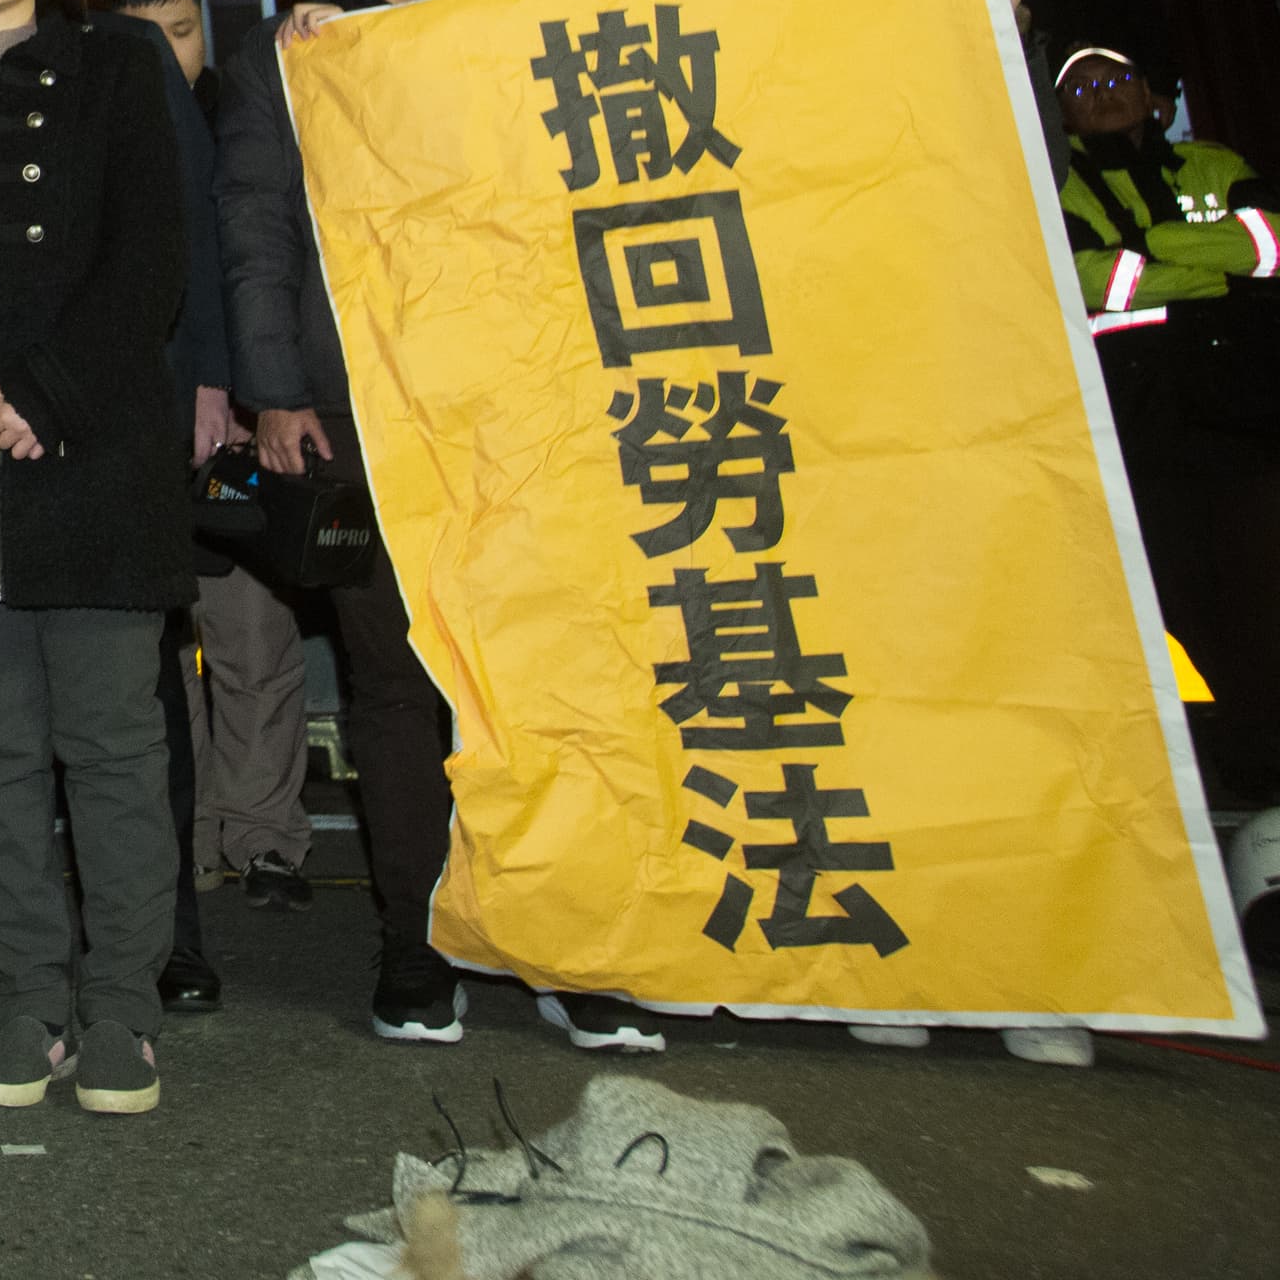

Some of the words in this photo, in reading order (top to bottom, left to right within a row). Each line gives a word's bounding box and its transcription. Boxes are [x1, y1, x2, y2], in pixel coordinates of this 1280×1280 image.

[531, 4, 908, 958] 撤回勞基法
